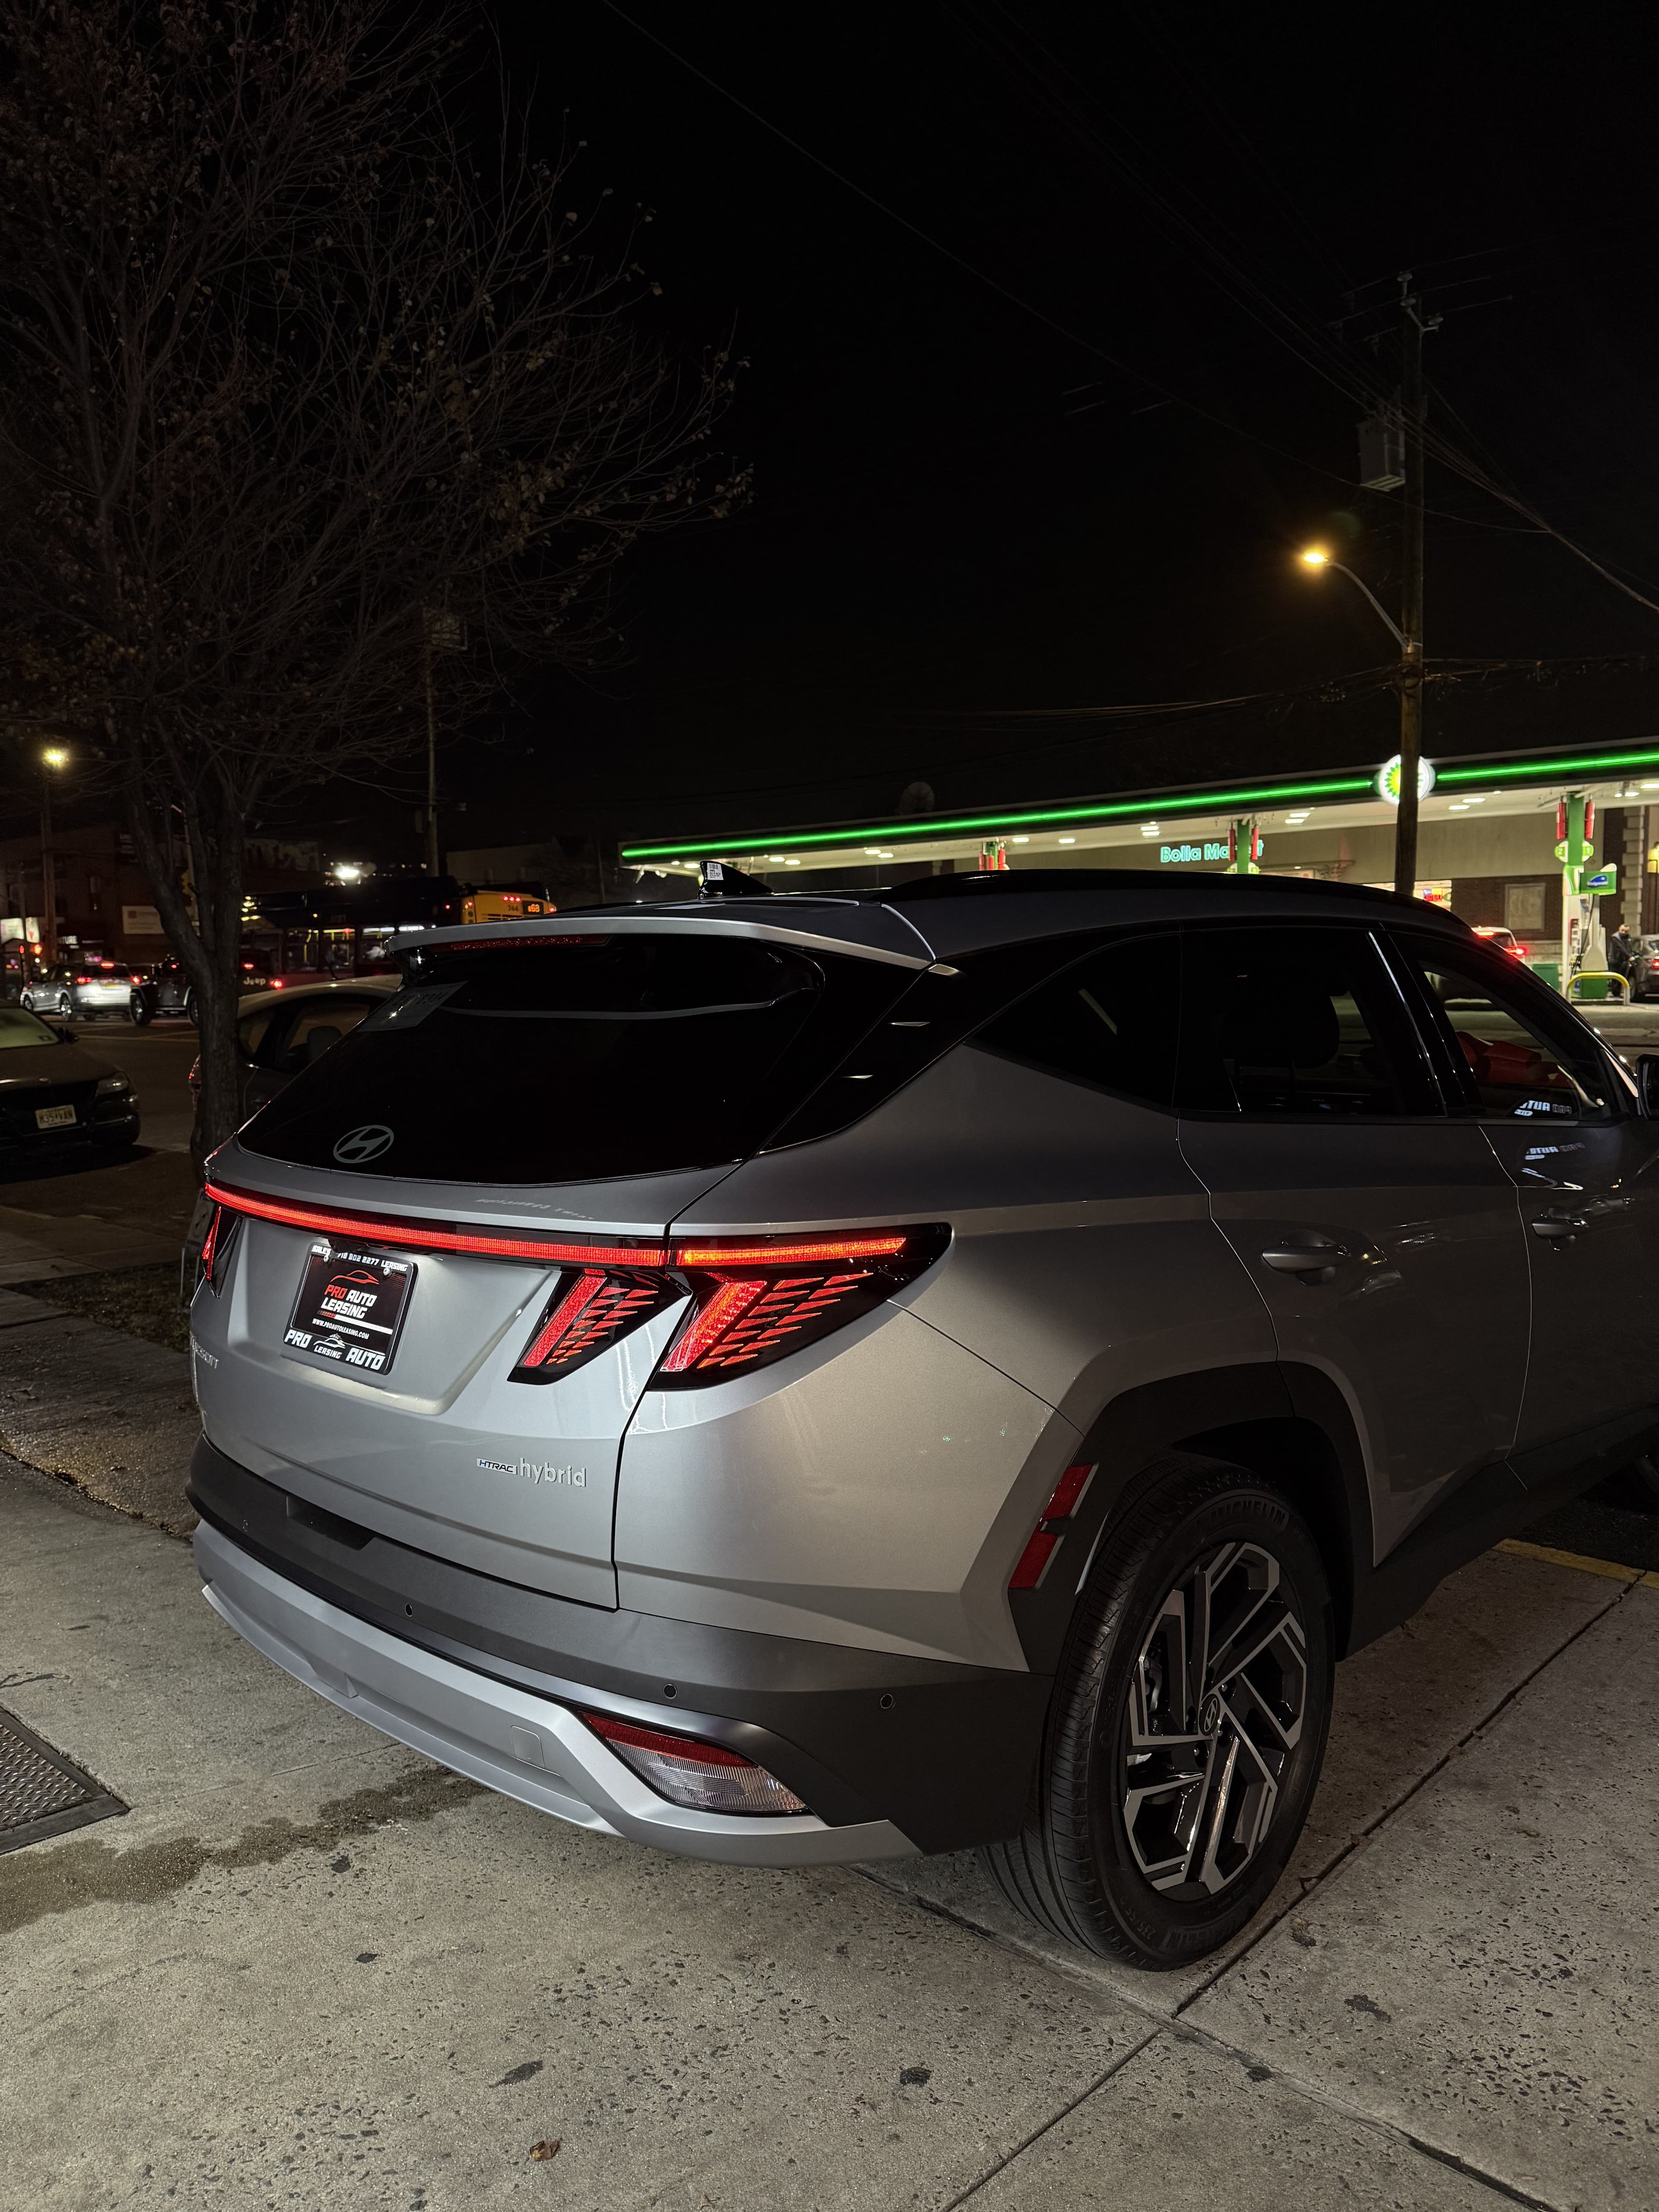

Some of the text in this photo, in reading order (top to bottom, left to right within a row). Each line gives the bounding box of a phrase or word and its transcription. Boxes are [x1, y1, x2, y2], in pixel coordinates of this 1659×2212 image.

[1160, 845, 1201, 863] Bolla
[243, 976, 266, 986] Jeep
[311, 1245, 331, 1255] SALES
[361, 1256, 380, 1266] 2277
[381, 1260, 408, 1272] LEASING
[324, 1284, 378, 1307] PRO AUTO
[321, 1297, 368, 1319] LEASING
[312, 1318, 369, 1339] WWW.PROAUTOLEASING.COM
[284, 1329, 386, 1370] PRO LEASING AUTO
[479, 1457, 586, 1487] HTRAC hybrid
